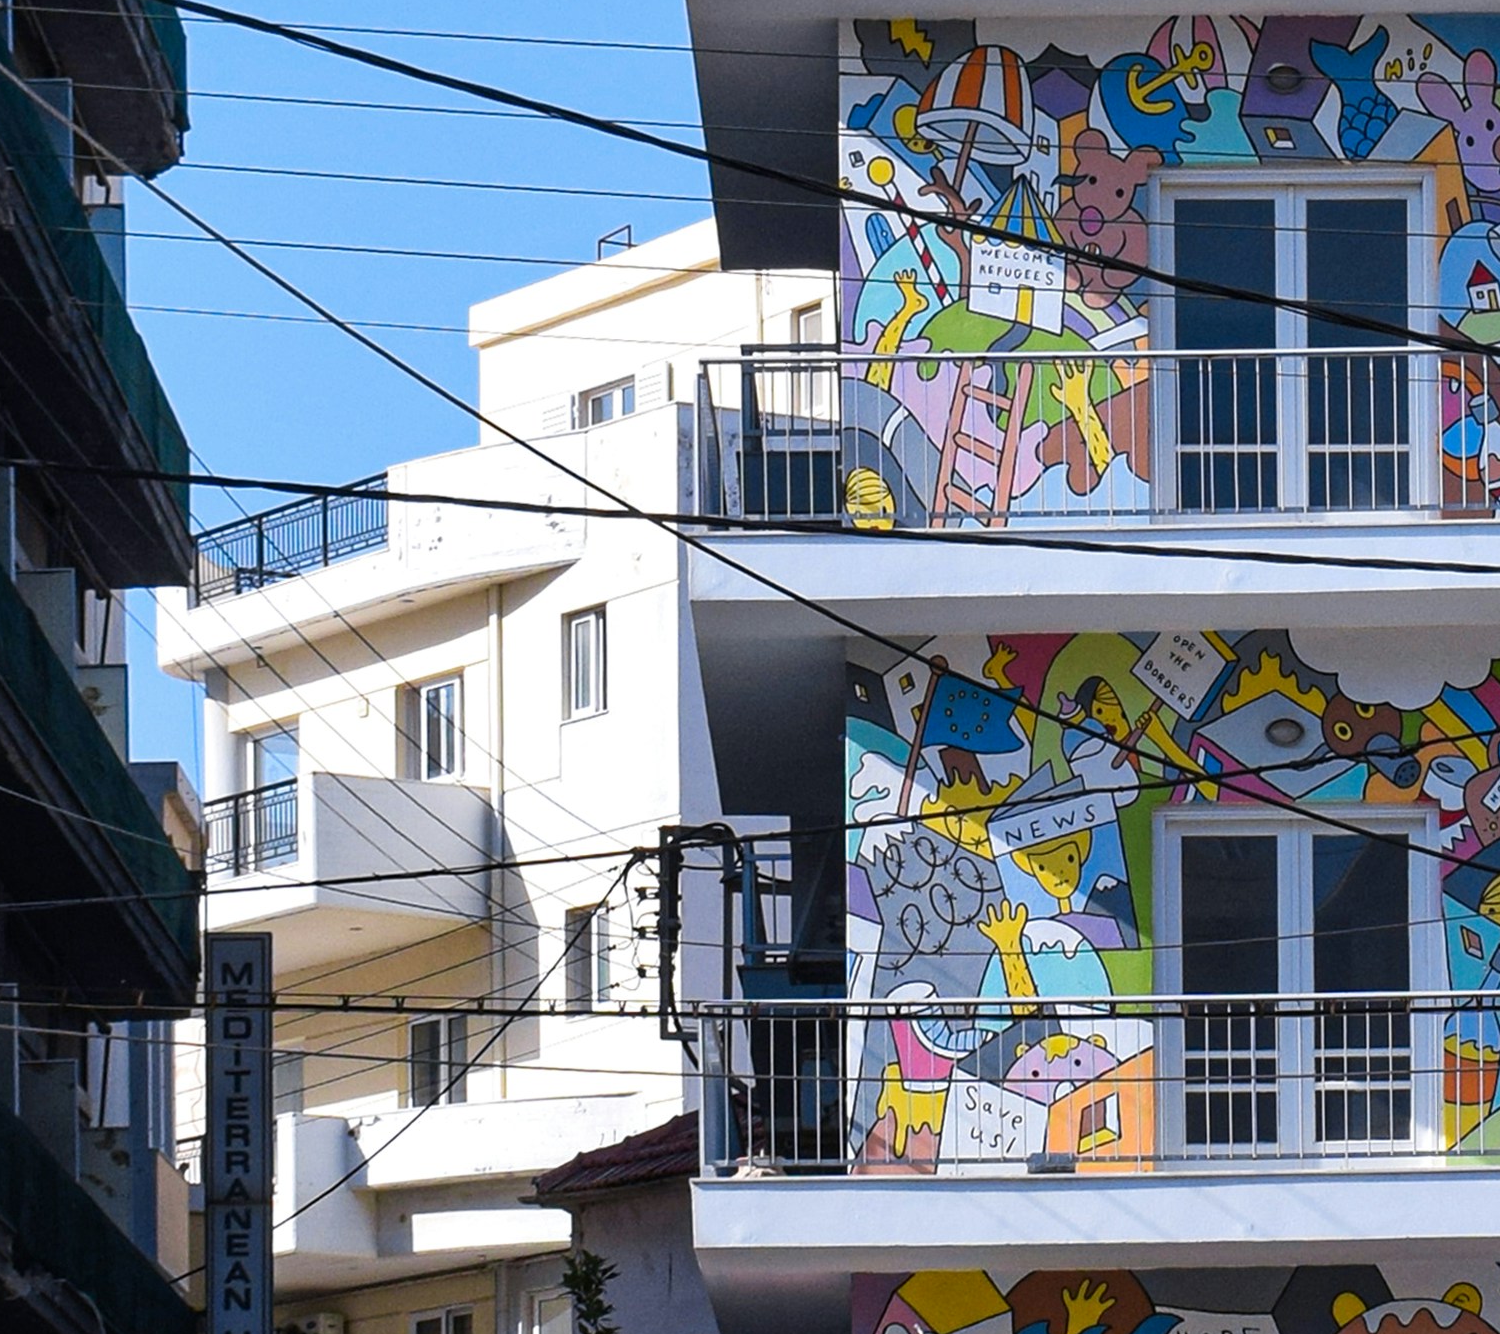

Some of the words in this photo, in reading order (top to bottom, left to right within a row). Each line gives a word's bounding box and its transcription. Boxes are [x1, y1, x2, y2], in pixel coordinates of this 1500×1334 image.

[980, 248, 1055, 267] WELCOME
[979, 265, 1055, 287] REFUGEES
[1173, 634, 1206, 660] OPEN
[1169, 651, 1192, 672] THE
[1143, 659, 1197, 710] BORDERS
[1005, 803, 1098, 847] NEWS
[965, 1086, 1022, 1131] Save
